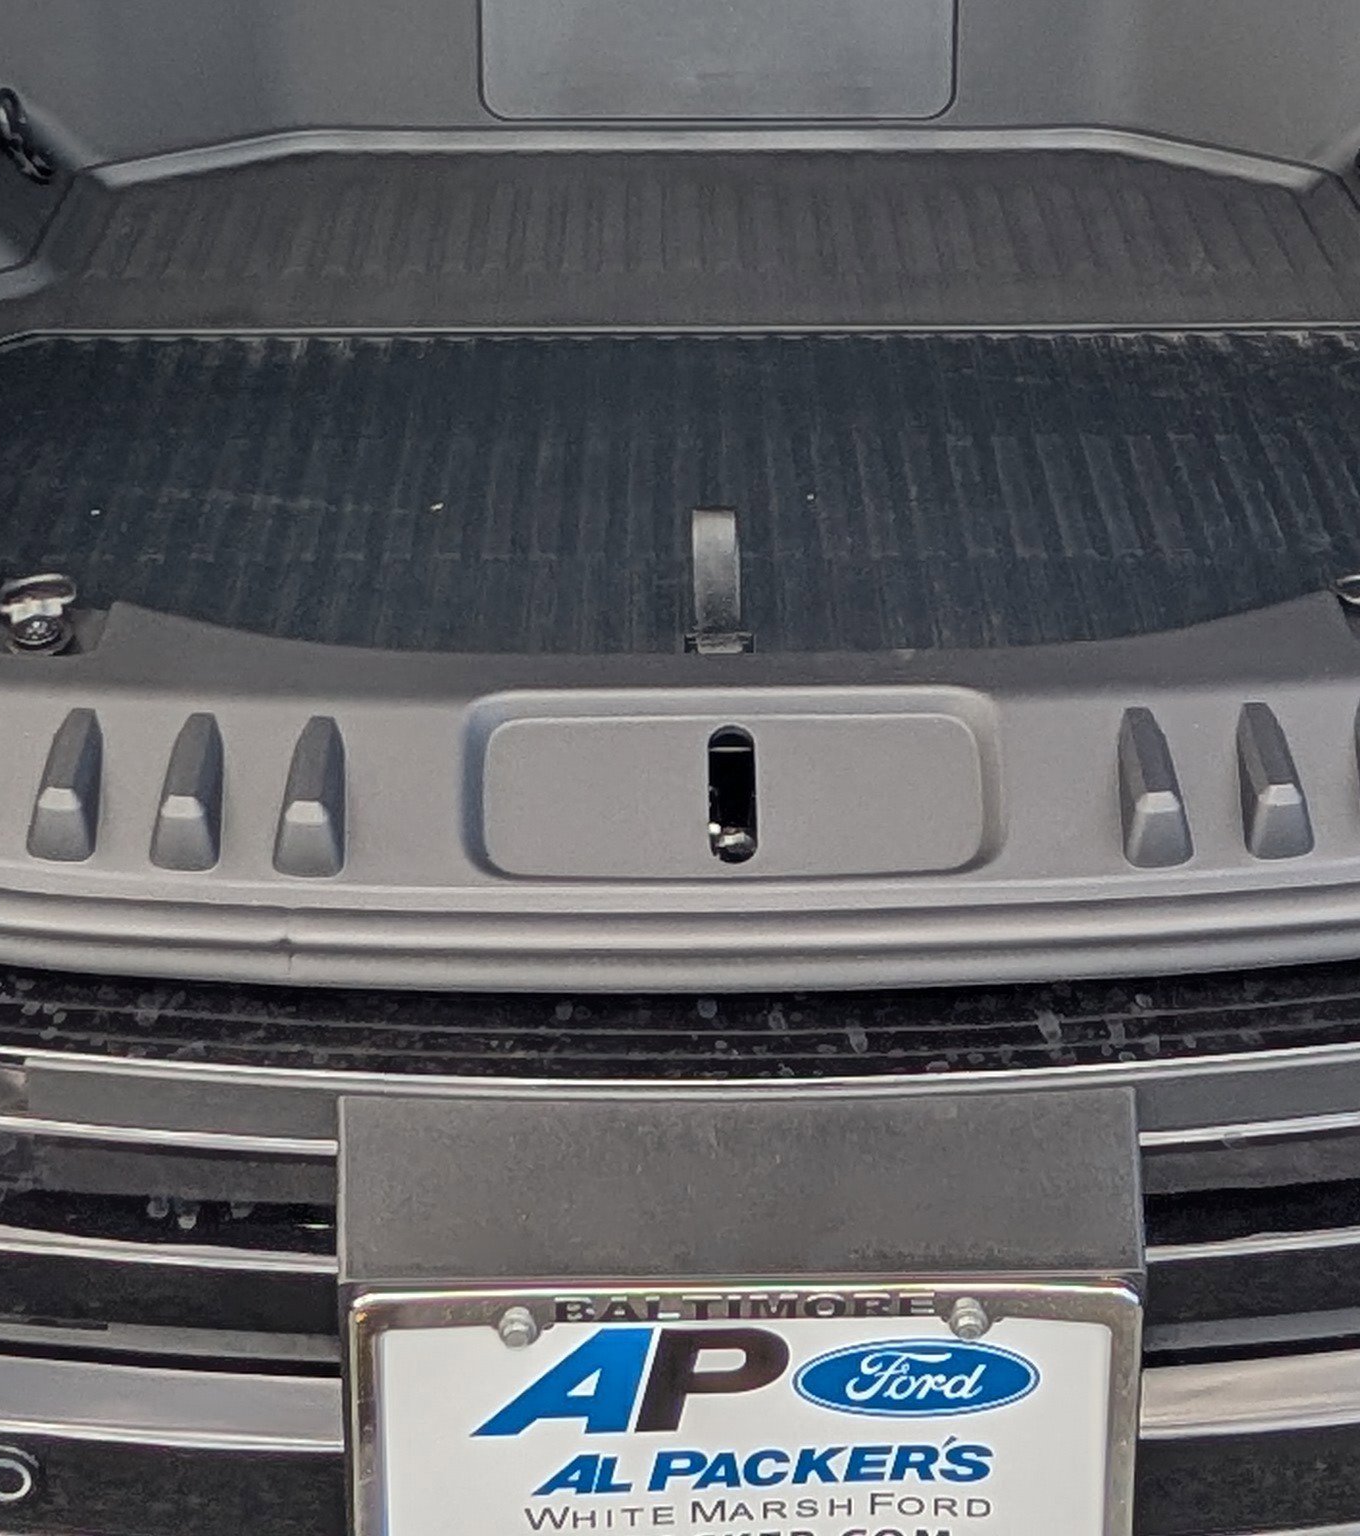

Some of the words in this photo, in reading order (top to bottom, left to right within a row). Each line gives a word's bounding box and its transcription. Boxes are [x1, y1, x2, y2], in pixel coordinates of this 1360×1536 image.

[554, 1293, 936, 1322] BALTIMORE
[469, 1328, 791, 1437] AP
[845, 1350, 987, 1402] Ford
[531, 1452, 633, 1496] AL
[647, 1435, 994, 1493] PACKER'S
[524, 1505, 675, 1531] WHITE
[691, 1497, 853, 1524] MARSH
[870, 1492, 992, 1518] FORD
